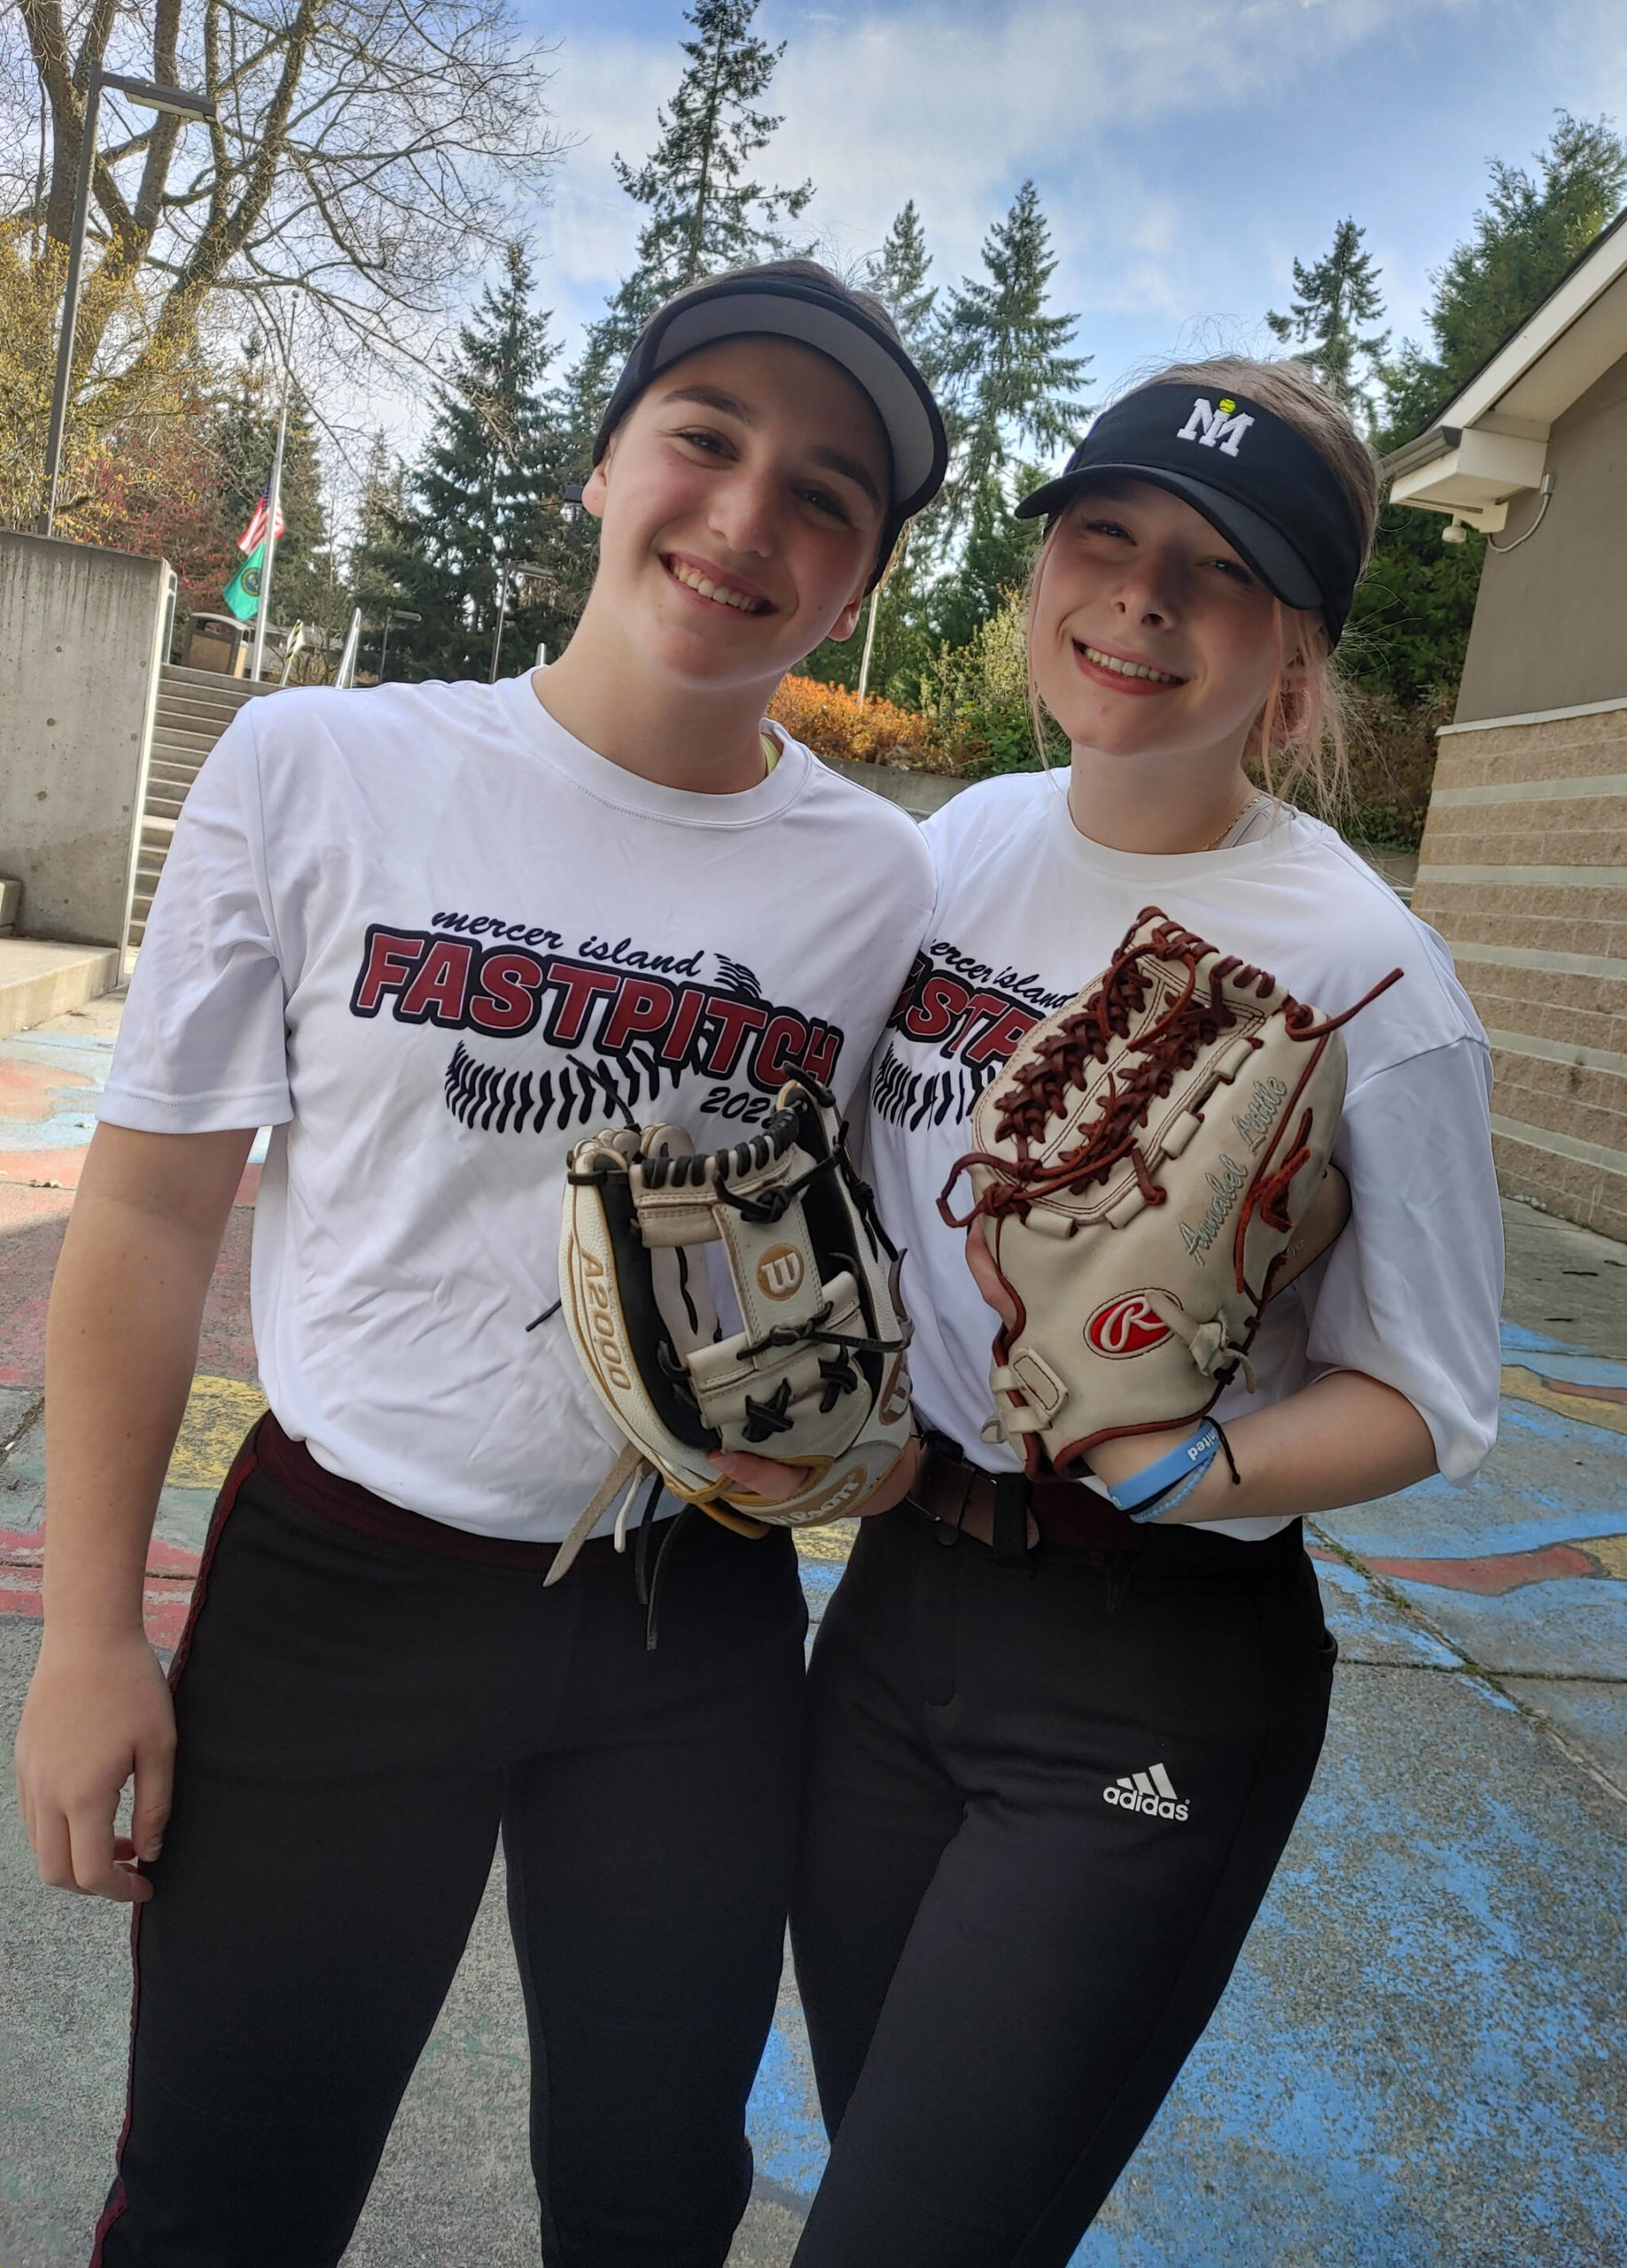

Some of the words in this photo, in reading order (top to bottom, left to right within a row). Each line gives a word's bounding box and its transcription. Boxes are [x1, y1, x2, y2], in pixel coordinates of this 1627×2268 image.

[432, 912, 564, 949] mercer
[579, 936, 705, 976] island
[930, 937, 993, 983] ercer
[349, 923, 845, 1094] FASTPITCH
[699, 1086, 774, 1130] 202
[1179, 1153, 1248, 1267] Annabel
[1232, 1076, 1287, 1156] Little
[580, 1247, 631, 1390] A2000
[1102, 1786, 1188, 1821] adidas
